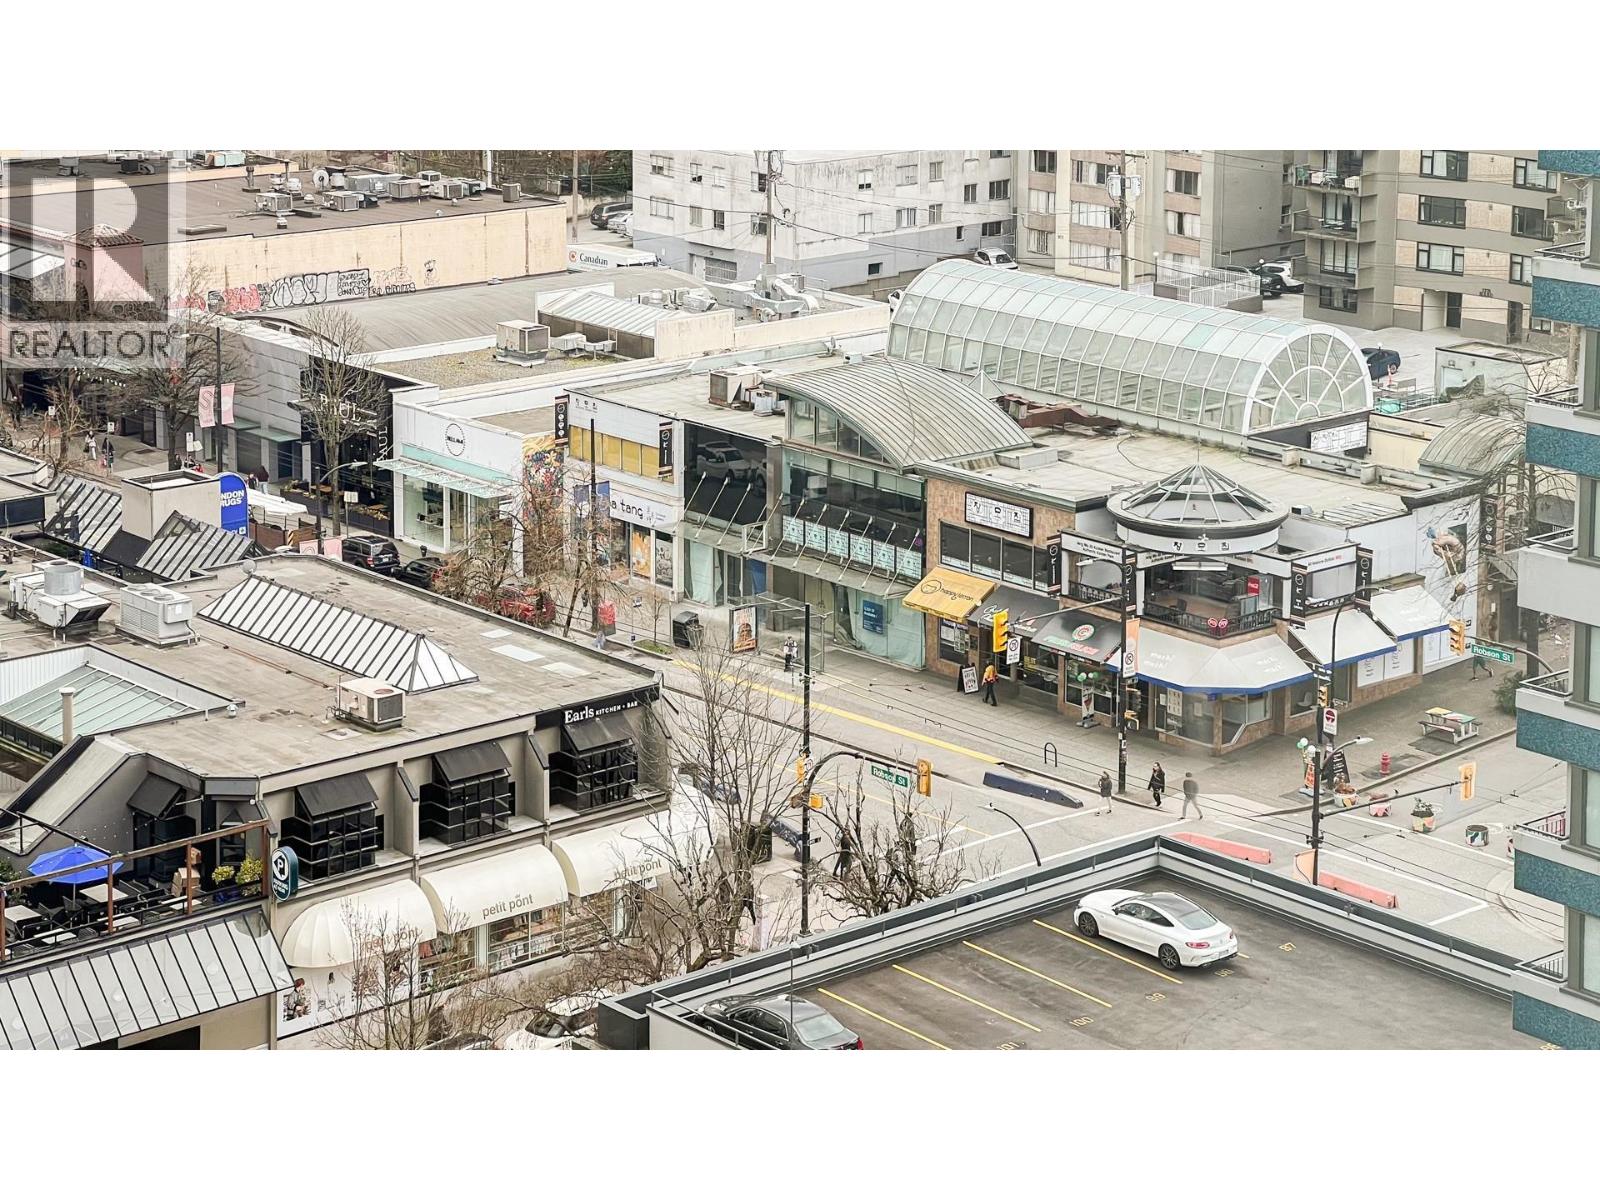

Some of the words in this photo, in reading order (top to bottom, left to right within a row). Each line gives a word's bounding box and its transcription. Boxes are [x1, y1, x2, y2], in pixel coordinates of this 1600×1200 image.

[320, 393, 361, 421] PUL
[220, 489, 245, 500] NDON
[220, 498, 242, 508] UGS
[620, 499, 643, 519] tang
[1473, 646, 1500, 659] Robson
[1502, 652, 1511, 662] St
[564, 706, 594, 724] Earls
[595, 706, 621, 716] KITCHEN
[627, 701, 638, 709] BAR
[873, 767, 895, 781] Robso
[897, 776, 906, 786] St
[482, 901, 507, 920] petit
[1069, 1016, 1094, 1027] 100
